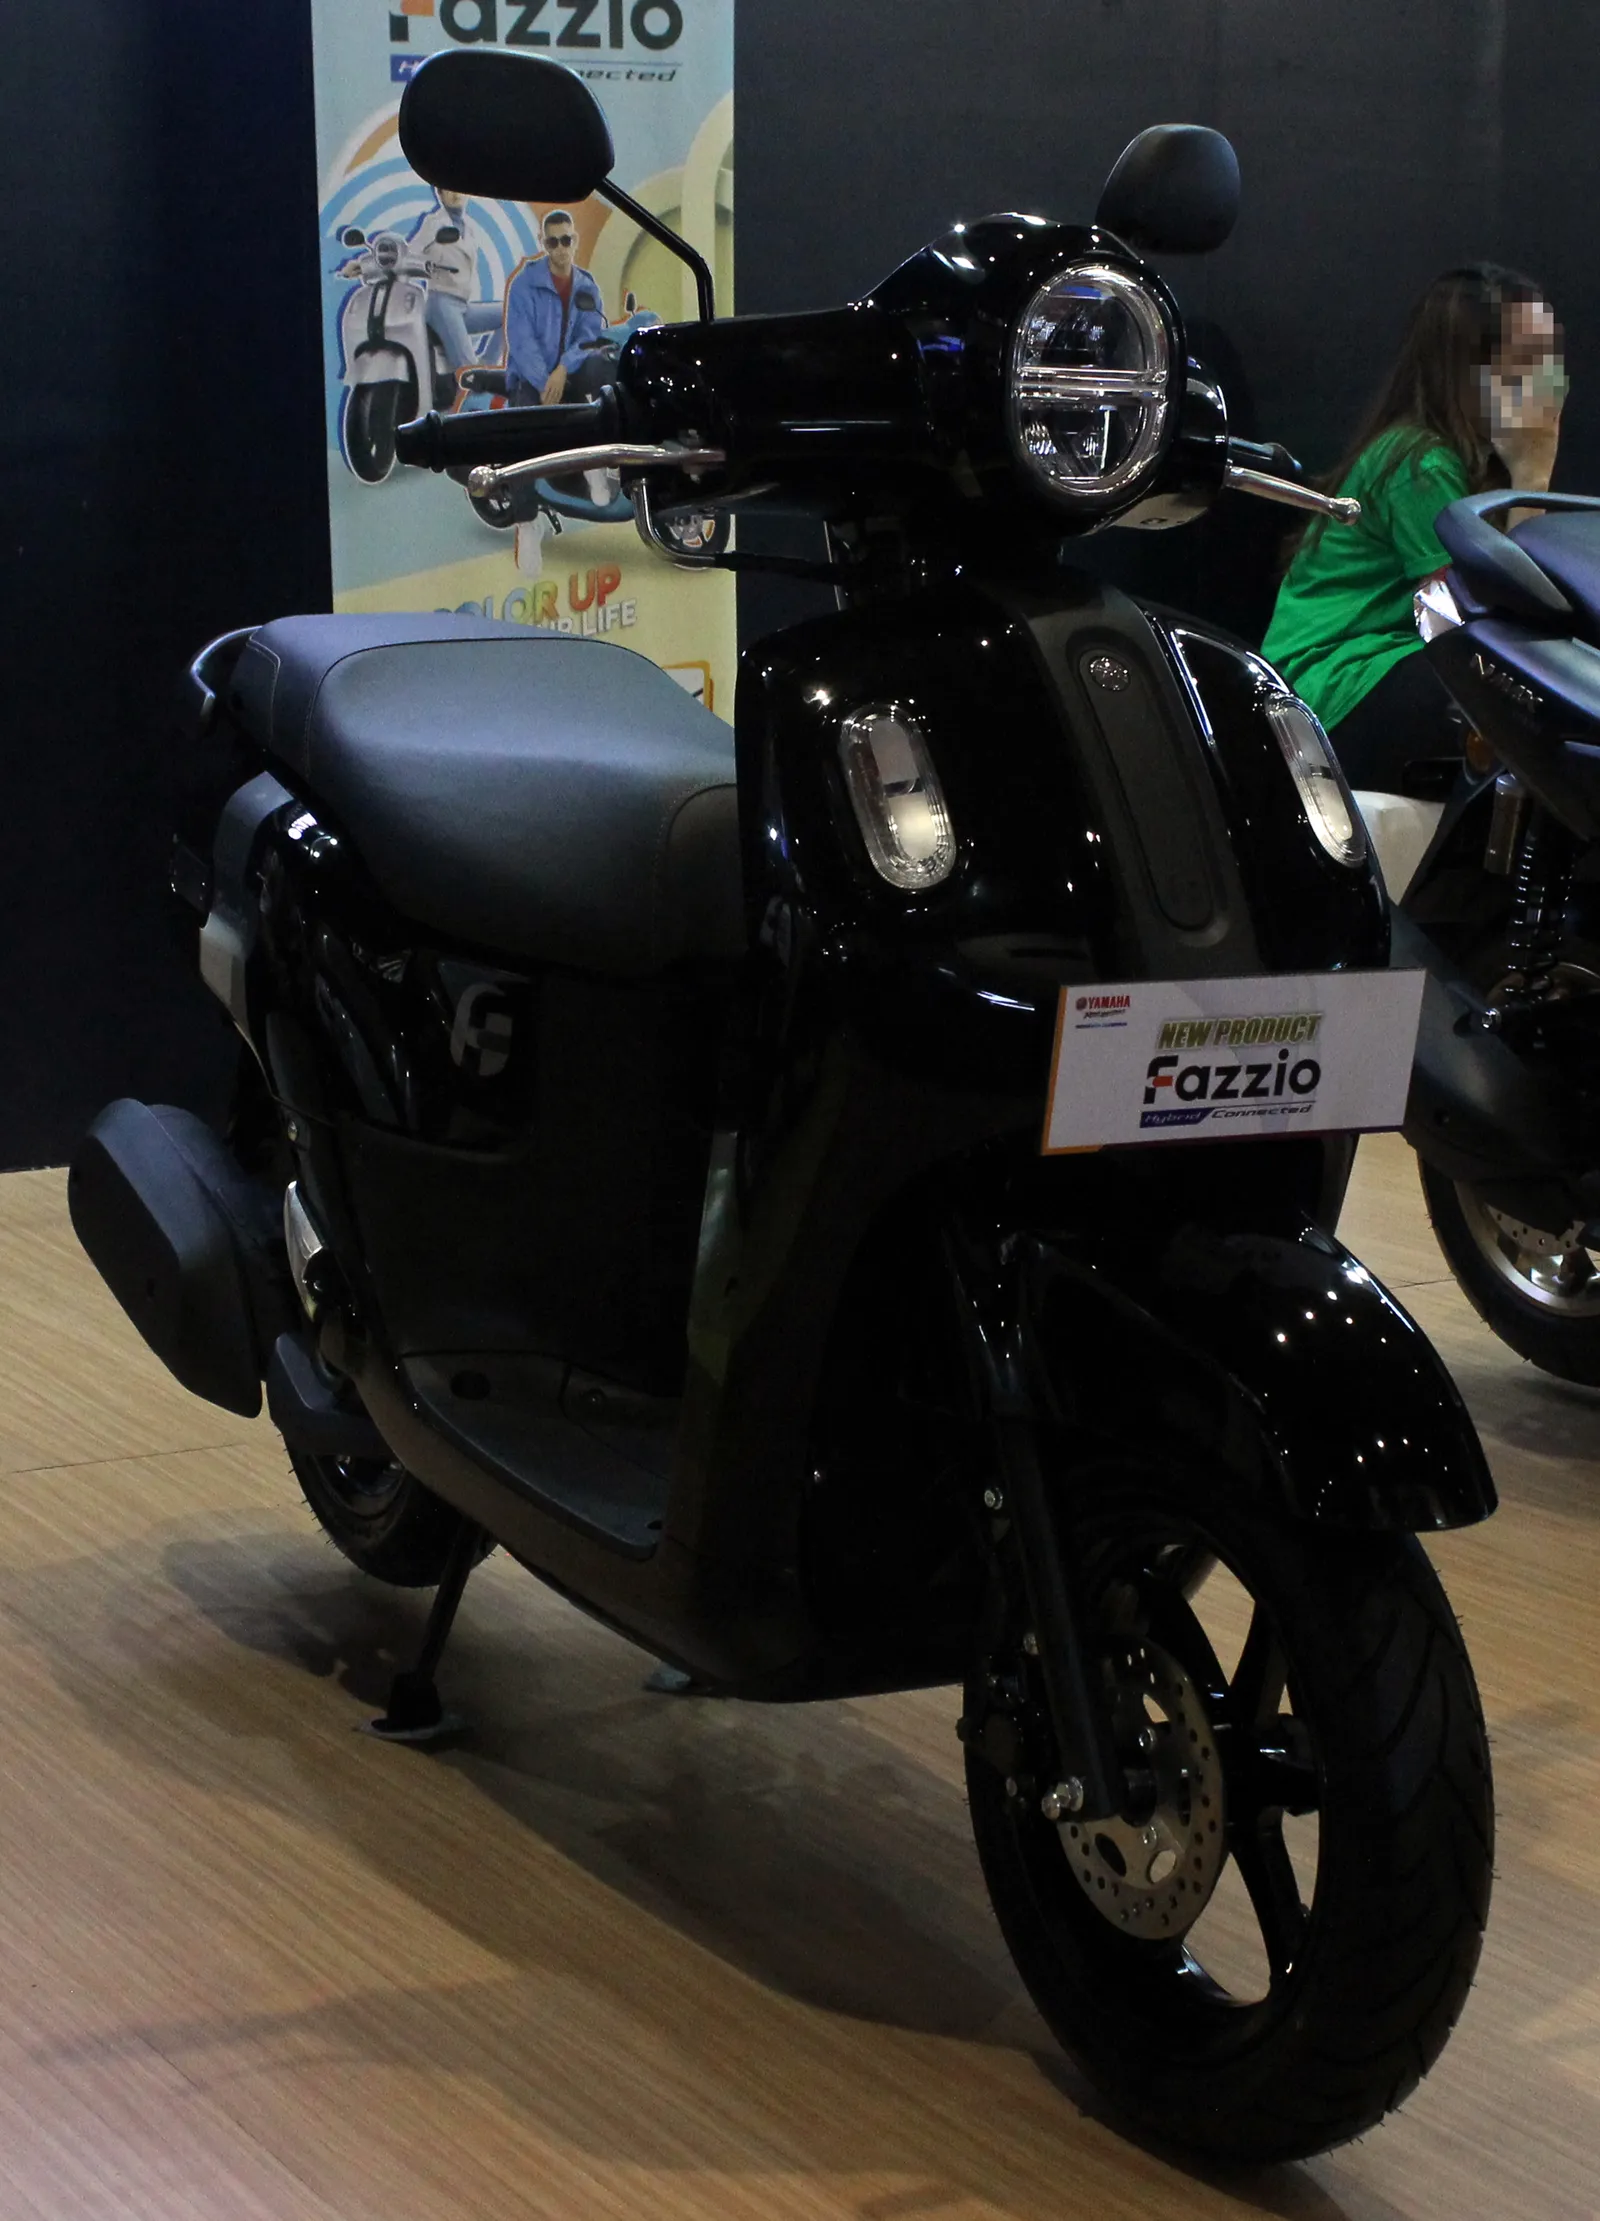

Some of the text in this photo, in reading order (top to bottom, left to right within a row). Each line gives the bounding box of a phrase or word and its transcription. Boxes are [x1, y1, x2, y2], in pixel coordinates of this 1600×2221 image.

[578, 69, 677, 83] ected
[434, 563, 621, 624] LOR UP
[581, 598, 638, 637] LIFE
[1088, 995, 1130, 1010] YAMAHA
[1157, 1013, 1323, 1050] NEW PRODUCT
[1143, 1048, 1322, 1105] Fazzio
[1142, 1104, 1313, 1124] Hybrid Connected
